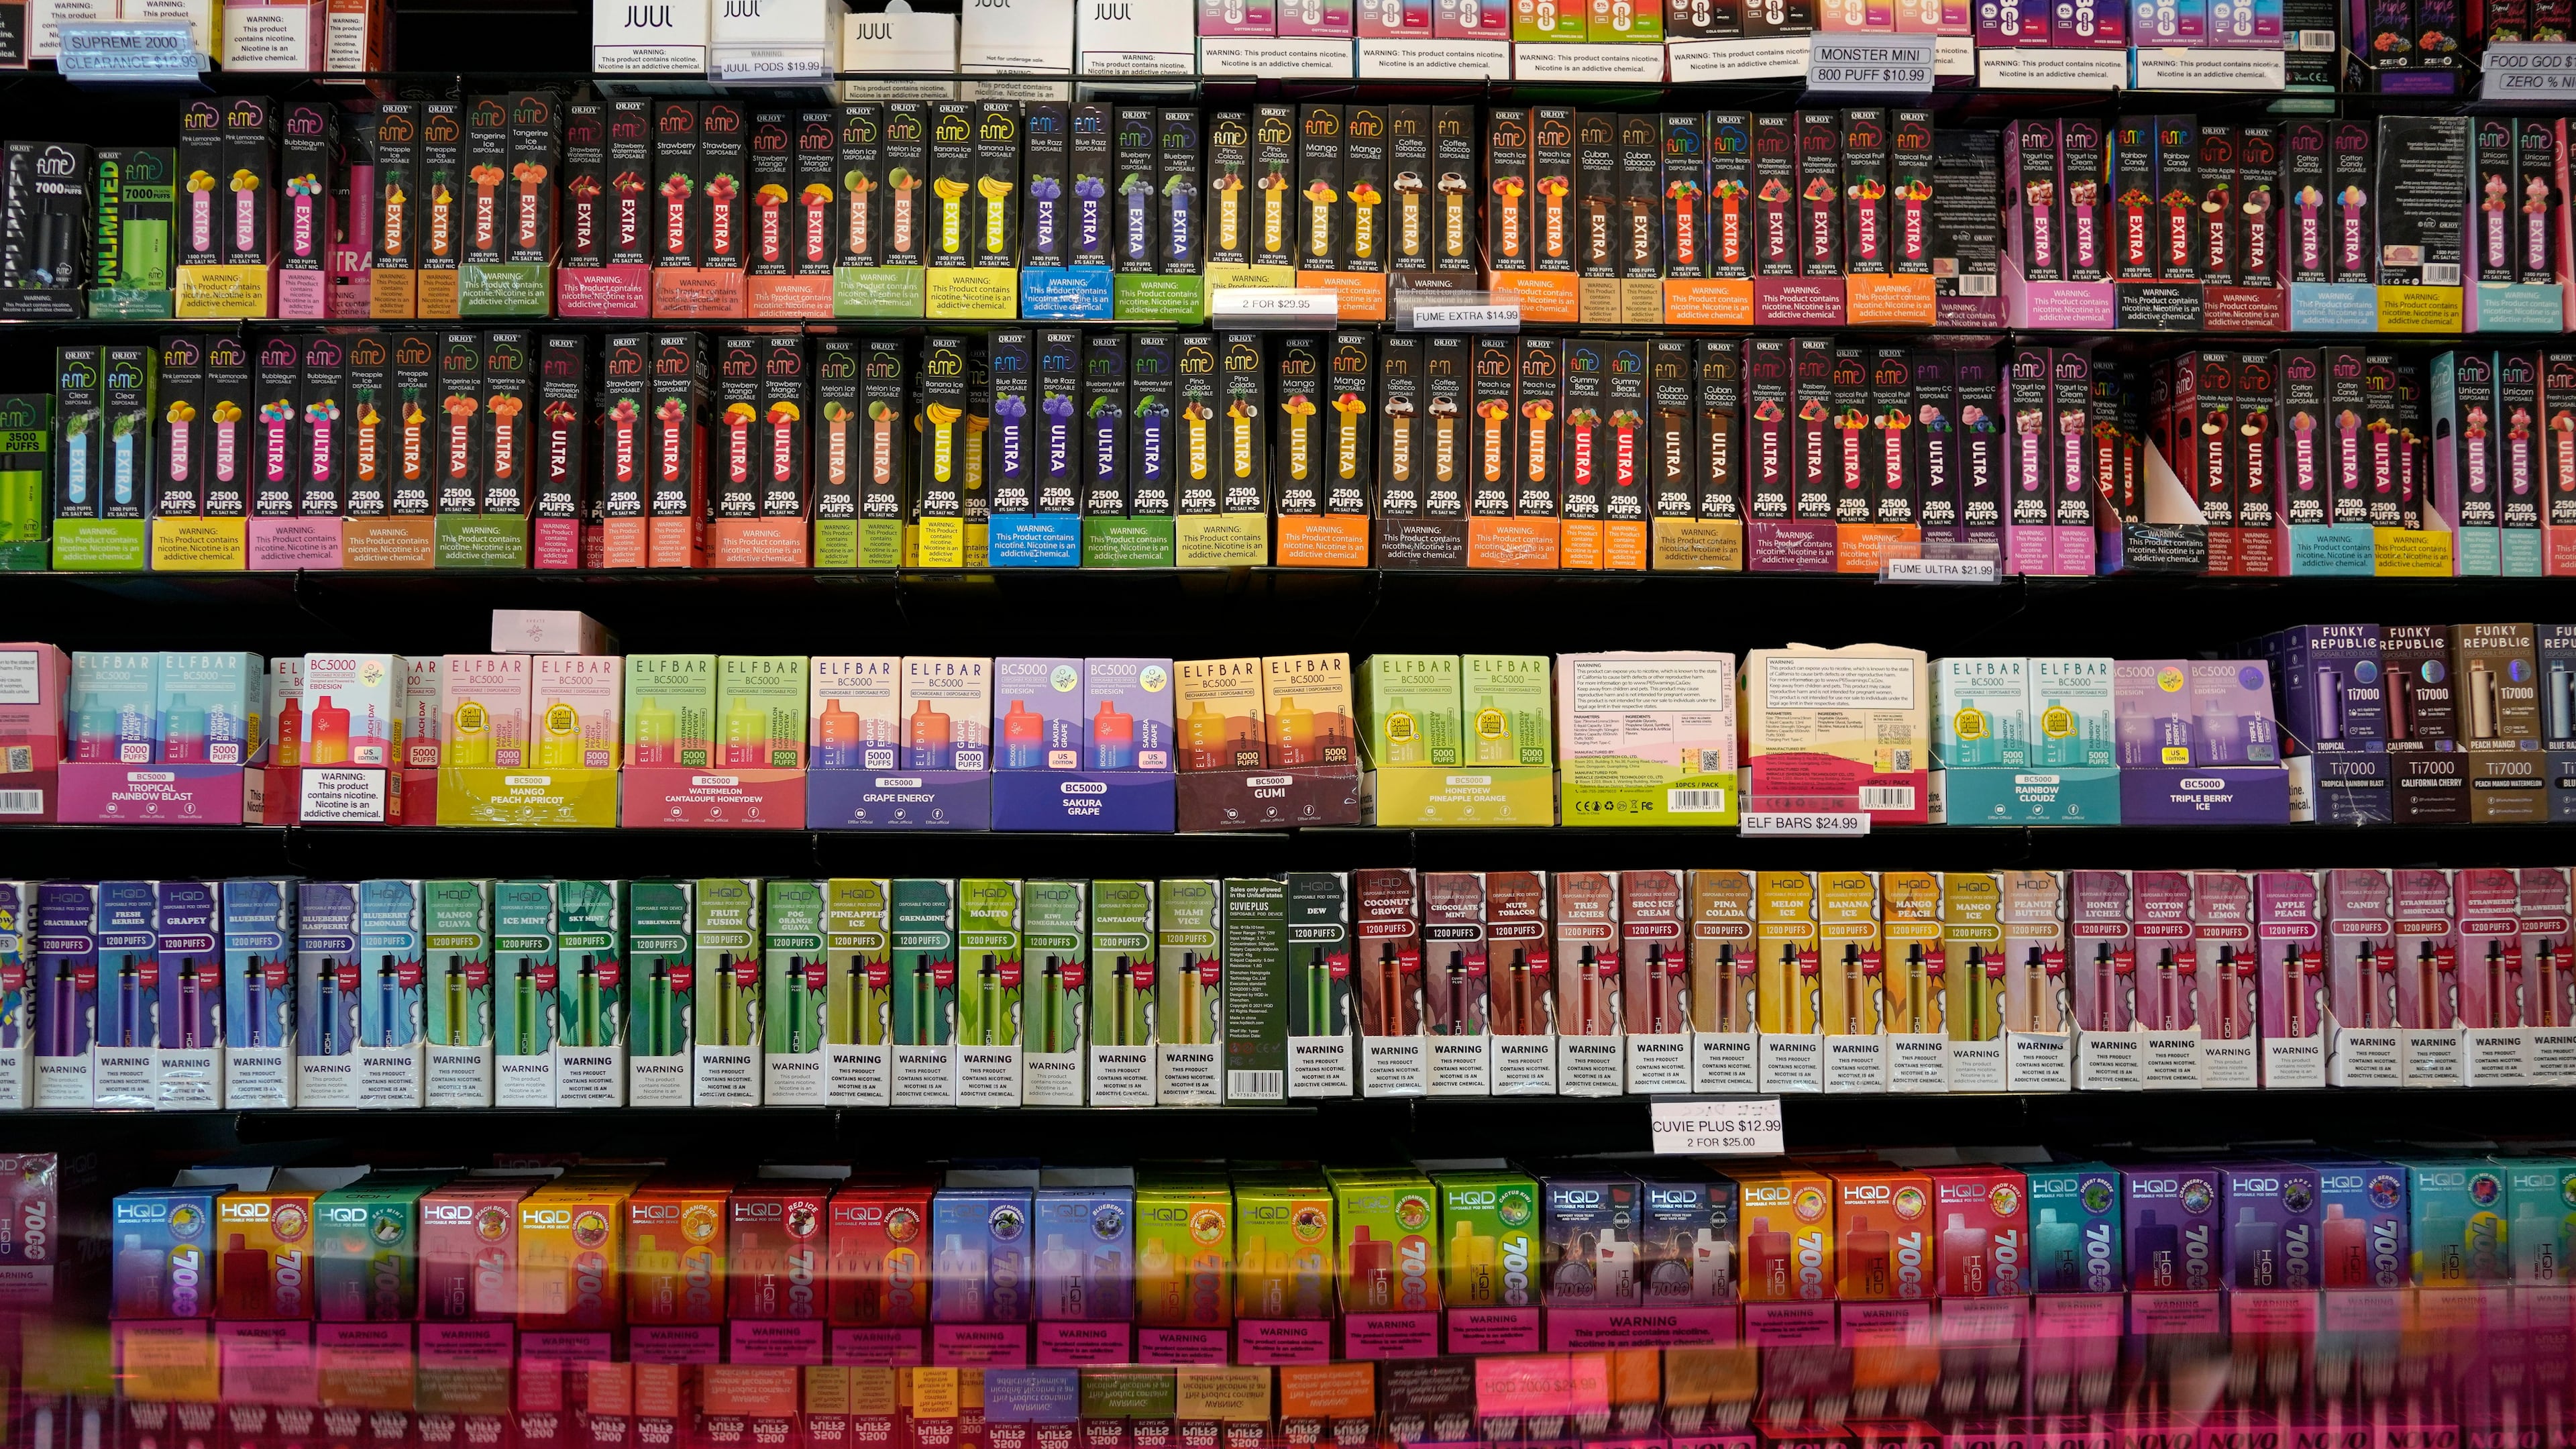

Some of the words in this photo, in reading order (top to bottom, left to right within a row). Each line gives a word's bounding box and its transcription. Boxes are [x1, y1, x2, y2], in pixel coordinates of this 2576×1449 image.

[625, 5, 672, 28] JUUL
[857, 23, 892, 40] JUUL
[72, 36, 142, 49] SUPREME
[146, 36, 178, 49] 2000
[1821, 49, 1888, 60] MONSTER
[1892, 50, 1919, 60] MINI
[66, 56, 150, 69] CLEARANCE
[154, 56, 198, 68] $12.99
[2491, 56, 2528, 67] FOOD
[2532, 56, 2562, 67] GOD
[724, 63, 750, 73] JUUL
[755, 62, 784, 73] PODS
[788, 62, 819, 72] $19.99
[1819, 69, 1841, 80] 800
[1845, 70, 1880, 80] PUFF
[1884, 69, 1924, 81] $10.99
[2506, 76, 2543, 87] ZERO
[2548, 76, 2558, 87] %
[2562, 77, 2576, 87] NI
[284, 140, 325, 148] Bubblegum
[702, 142, 741, 151] Strawberry
[1306, 144, 1337, 154] Mango
[2219, 168, 2235, 176] Apple
[125, 189, 152, 199] 7000
[297, 205, 310, 251] EXTRA
[1242, 300, 1248, 308] 2
[1252, 300, 1274, 308] FOR
[1278, 299, 1310, 309] $29.95
[1416, 313, 1444, 321] FUME
[1449, 312, 1483, 321] EXTRA
[1487, 311, 1517, 320] $14.99
[9, 433, 36, 441] 3500
[6, 442, 39, 451] PUFFS
[173, 428, 186, 475] ULTRA
[165, 491, 193, 500] 2500
[160, 500, 196, 509] PUFFS
[1893, 565, 1921, 573] FUME
[1925, 566, 1958, 574] ULTRA
[1962, 566, 1992, 574] $21.99
[2312, 638, 2377, 649] REPUBLIC
[311, 659, 356, 670] BC5000
[2348, 688, 2379, 700] Ti7000
[2402, 778, 2438, 788] CALIFORNIA
[2439, 777, 2462, 788] CHERRY
[863, 794, 895, 802] GRAPE
[898, 794, 935, 802] ENERGY
[1254, 788, 1285, 798] GUMI
[2170, 794, 2201, 802] TRIPLE
[1063, 799, 1102, 807] SAKURA
[1748, 818, 1771, 828] ELF
[1776, 817, 1812, 828] BARS
[1816, 817, 1858, 829] $24.99
[970, 910, 1008, 918] MOJITO
[168, 916, 207, 924] GRAPEY
[165, 939, 181, 948] 1200
[184, 938, 205, 947] PUFFS
[1296, 1046, 1344, 1054] WARNING
[1653, 1121, 1695, 1132] CUVIE
[1699, 1120, 1735, 1132] PLUS
[1739, 1120, 1780, 1132] $12.99
[1688, 1138, 1693, 1147] 2
[1697, 1138, 1720, 1147] FOR
[1723, 1138, 1755, 1146] $25.00
[1450, 1191, 1495, 1205] HQD
[633, 1205, 680, 1218] HQD
[1470, 1315, 1517, 1323] WARNING
